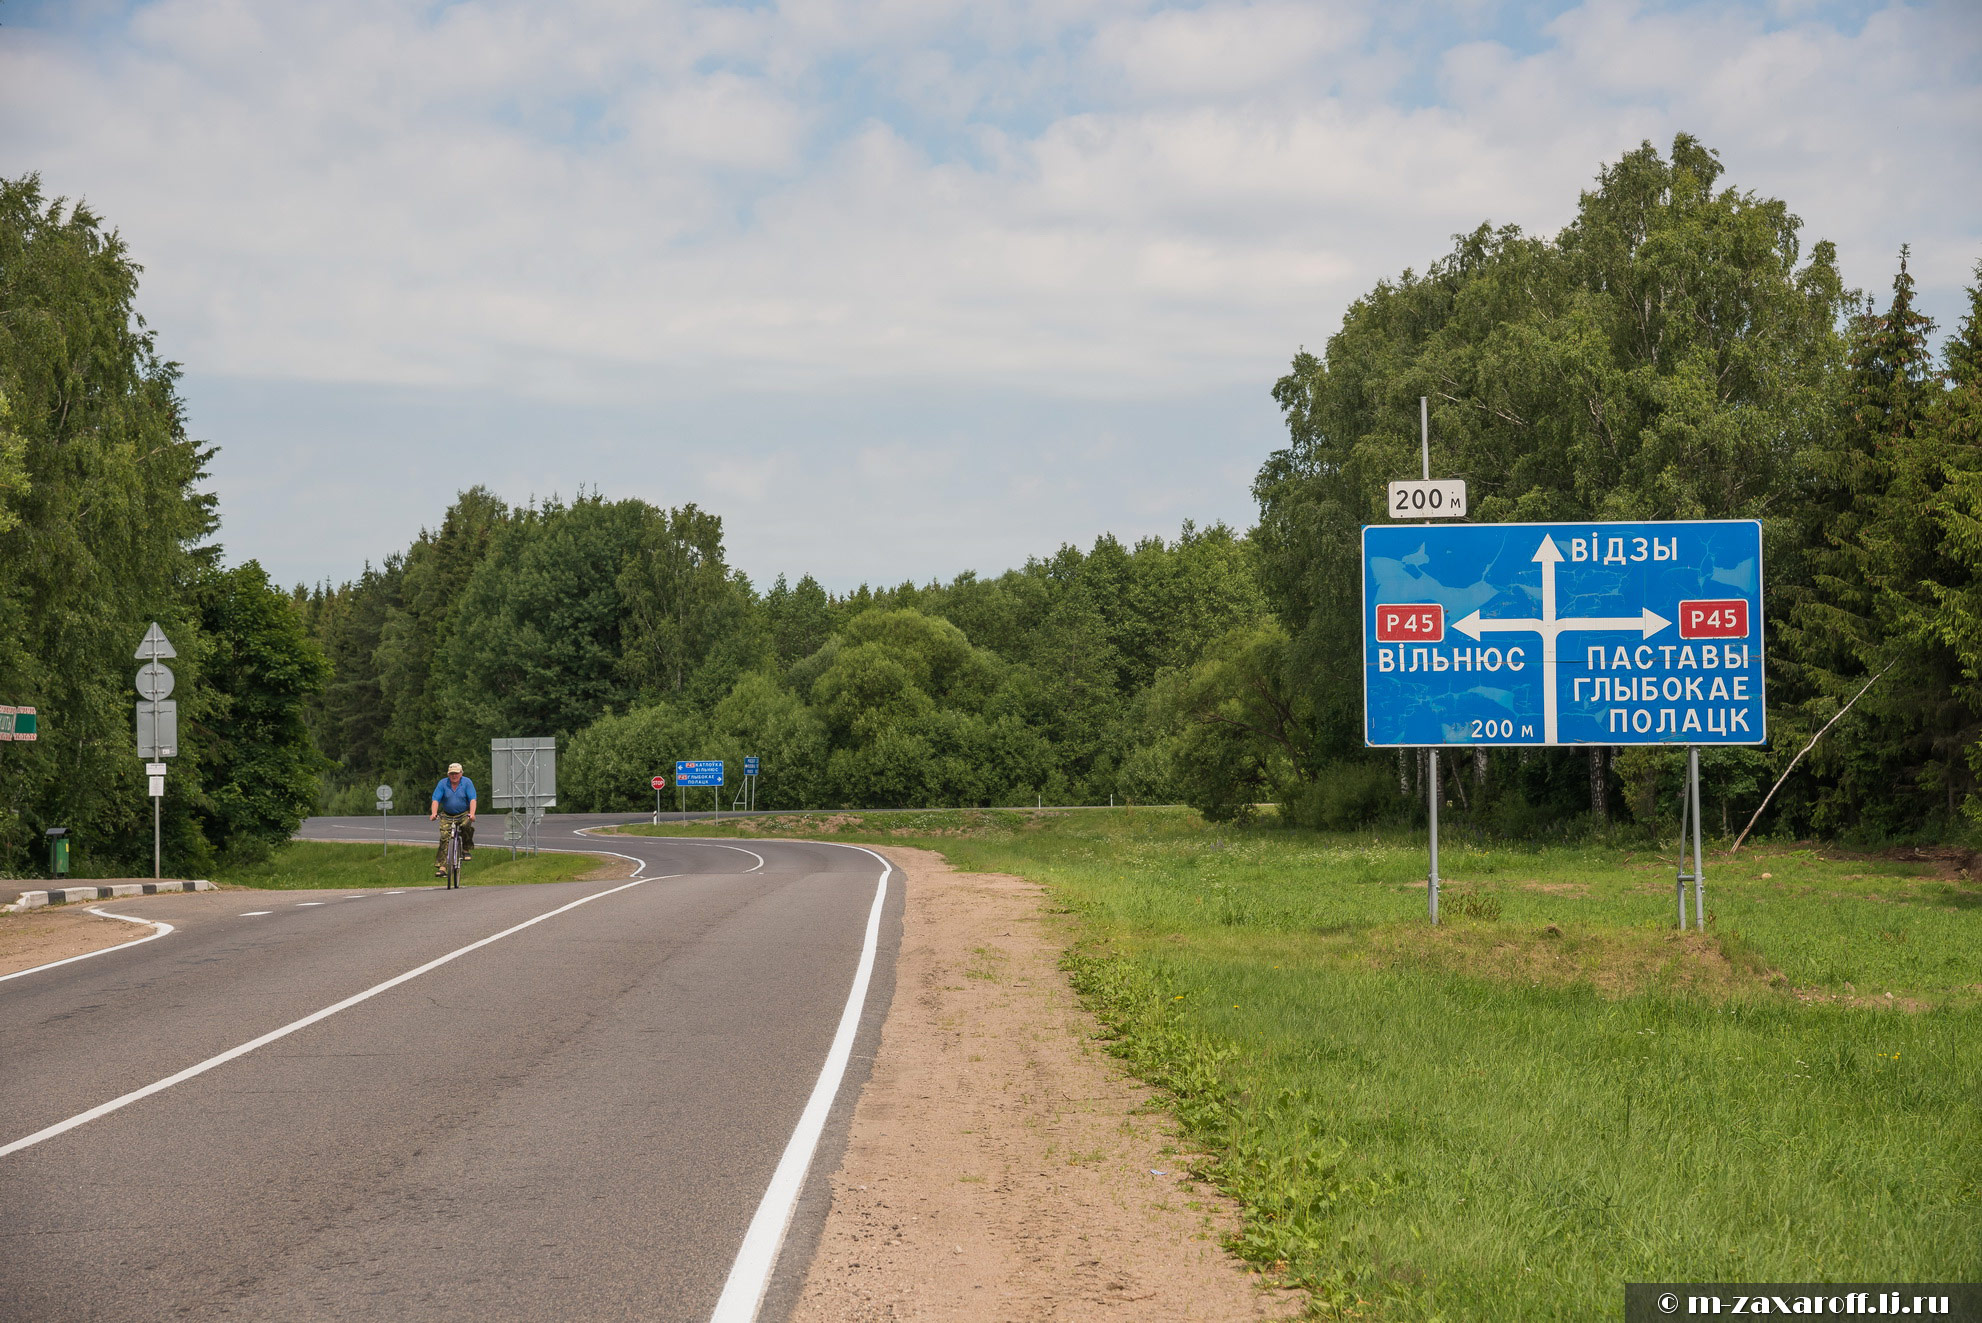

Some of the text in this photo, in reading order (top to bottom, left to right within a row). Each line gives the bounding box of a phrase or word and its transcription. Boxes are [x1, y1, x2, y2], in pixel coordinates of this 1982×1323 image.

[1395, 488, 1443, 510] 200
[1587, 644, 1749, 670] ПАСТАВЫ
[1573, 676, 1750, 702] ГЛЫБОКАЕ
[1471, 719, 1513, 738] 200
[1609, 708, 1750, 737] ПОЛАЦК
